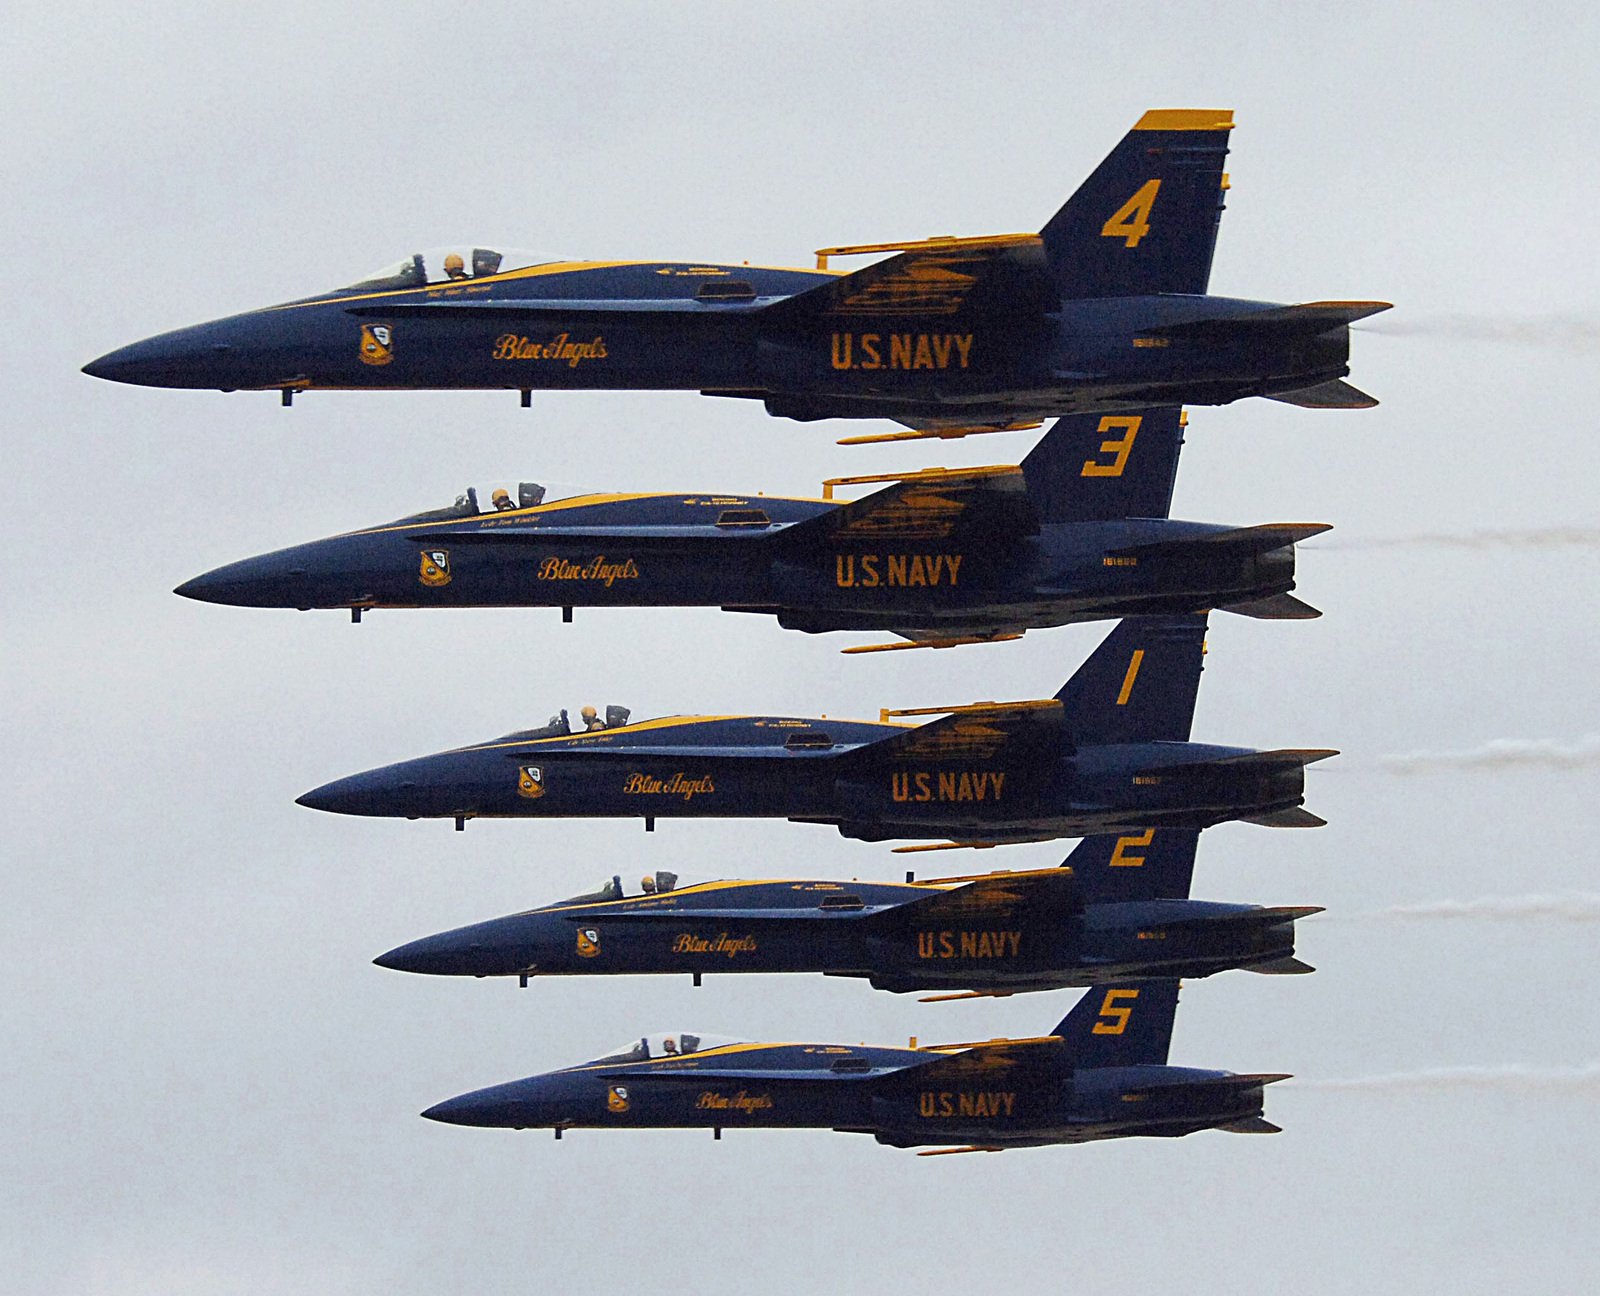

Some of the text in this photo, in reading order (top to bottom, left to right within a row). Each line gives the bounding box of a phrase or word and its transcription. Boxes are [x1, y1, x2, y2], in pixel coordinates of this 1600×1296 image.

[1101, 178, 1162, 248] 4
[492, 332, 609, 368] Blue Angels
[1080, 416, 1143, 477] 3
[537, 555, 640, 588] Blue Angels
[1116, 649, 1145, 705] 1
[623, 772, 716, 801] Blue Angels
[1109, 828, 1155, 868] 2
[672, 932, 758, 958] Blue Angels
[1092, 988, 1140, 1035] 5
